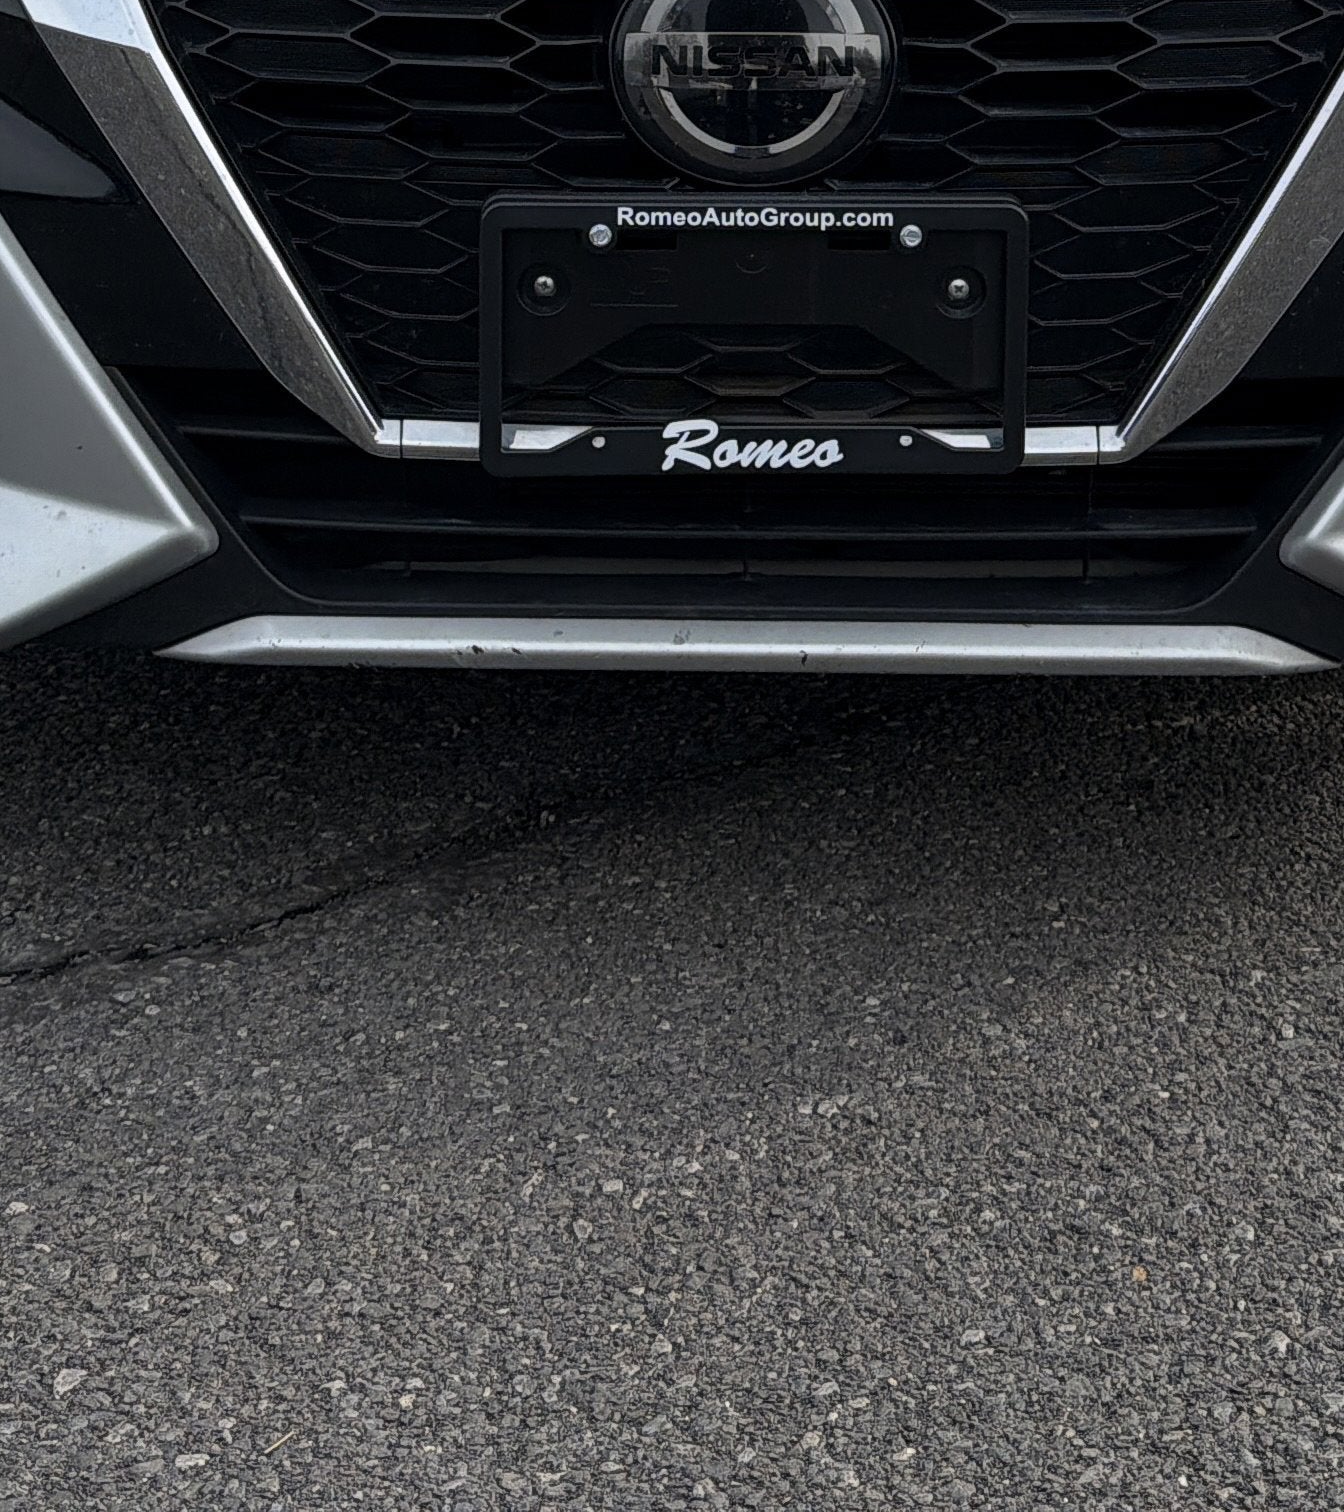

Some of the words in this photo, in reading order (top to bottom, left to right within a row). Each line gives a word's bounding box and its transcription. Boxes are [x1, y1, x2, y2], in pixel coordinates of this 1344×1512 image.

[652, 44, 856, 77] NISSAN
[617, 207, 894, 231] RomeoAutoGroup.com
[661, 419, 844, 471] Romeo
